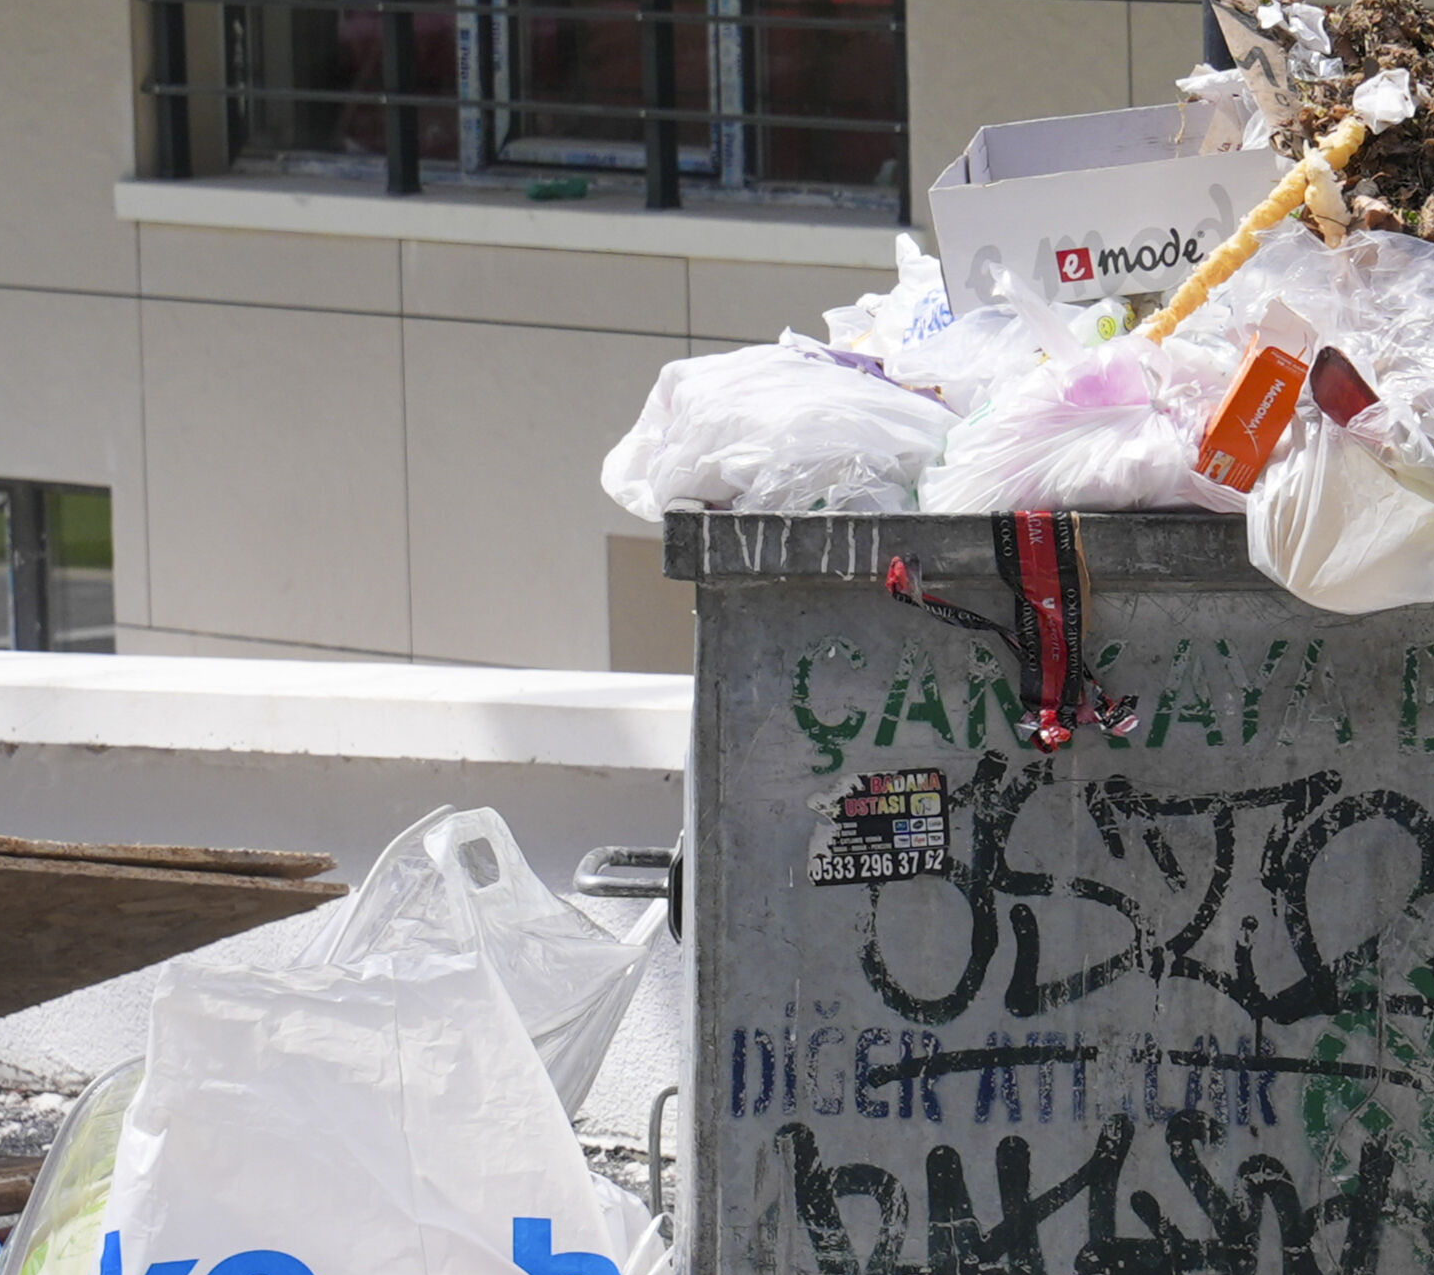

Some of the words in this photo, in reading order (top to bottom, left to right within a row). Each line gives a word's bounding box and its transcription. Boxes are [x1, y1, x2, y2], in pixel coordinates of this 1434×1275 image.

[869, 772, 942, 795] BADANA
[844, 794, 907, 818] USTASI
[812, 854, 856, 881] 0533
[859, 852, 894, 878] 296
[897, 850, 920, 875] 37
[729, 996, 943, 1125] DİĞER
